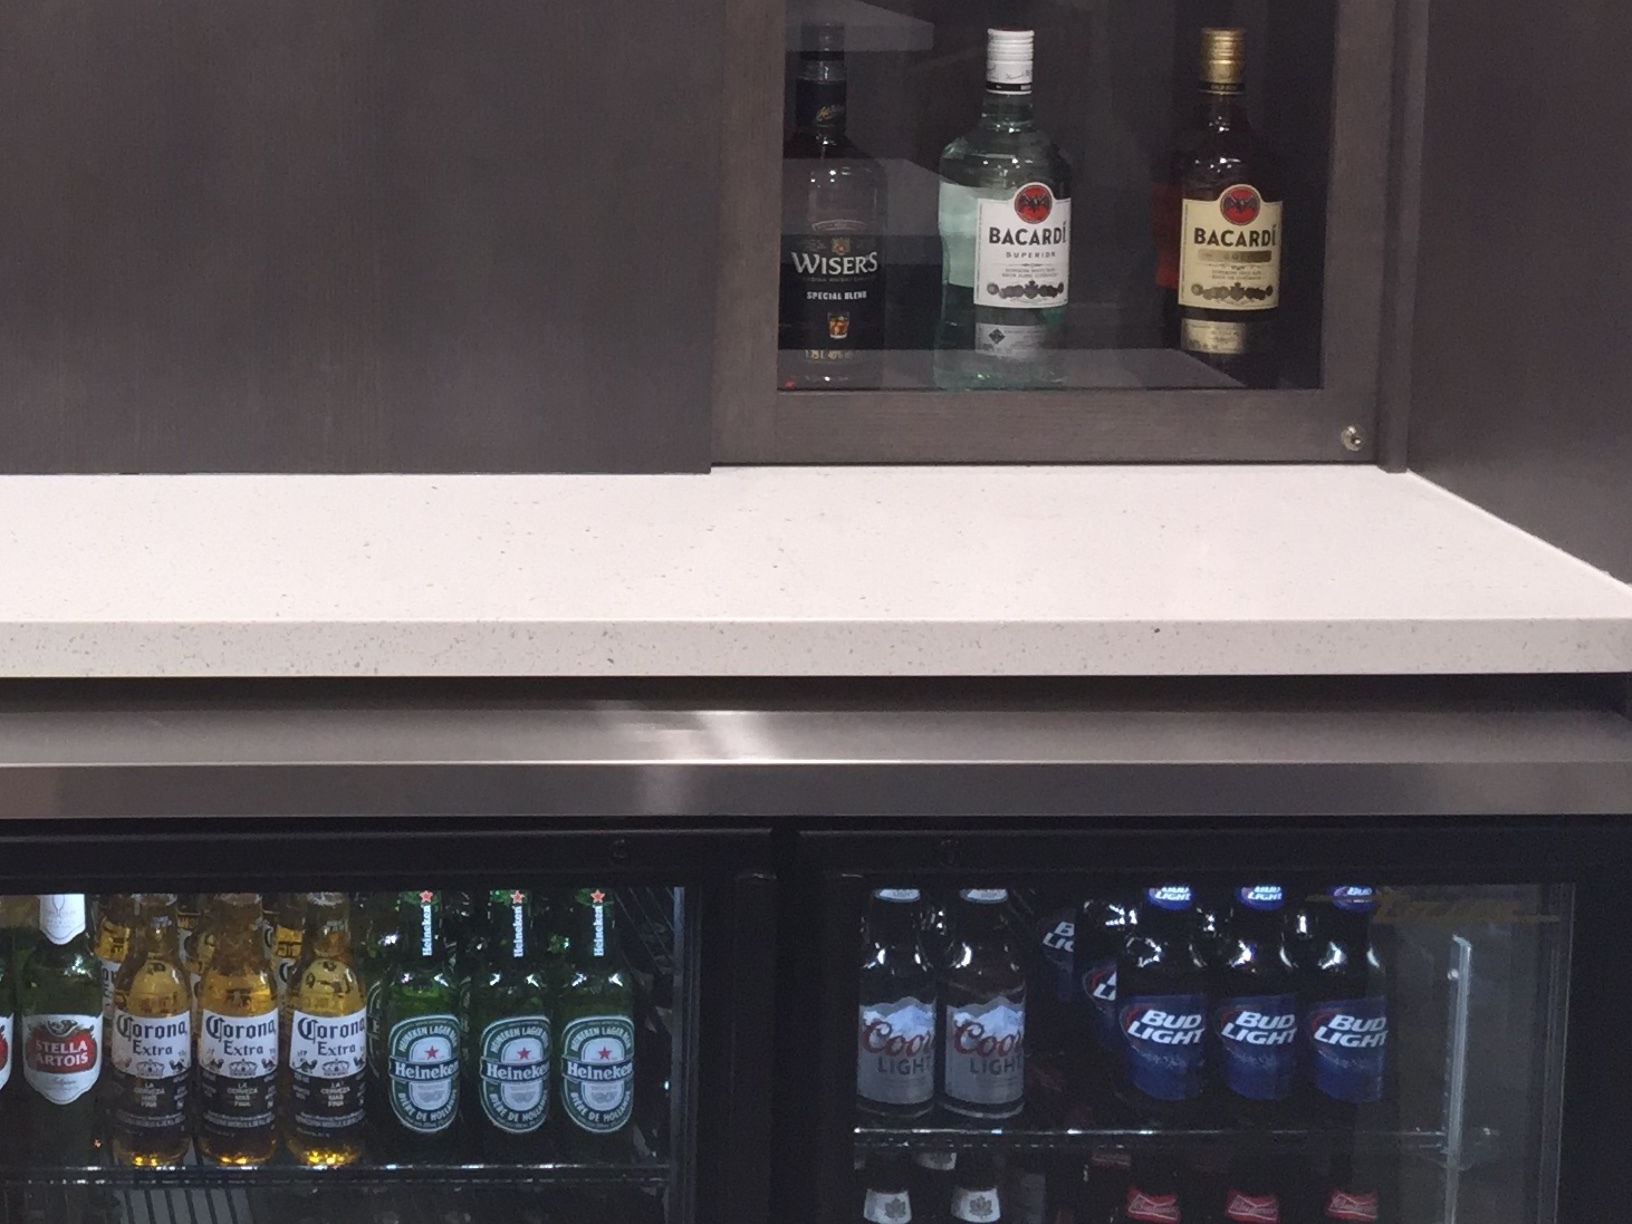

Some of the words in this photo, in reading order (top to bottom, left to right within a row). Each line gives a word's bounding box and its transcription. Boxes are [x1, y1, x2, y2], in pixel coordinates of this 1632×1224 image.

[988, 221, 1067, 247] BACARDÍ
[1194, 224, 1277, 248] BACARDÍ
[1005, 251, 1057, 259] SUPERIOR
[806, 290, 842, 300] SPECIAL
[844, 290, 868, 300] BLEND
[421, 903, 432, 956] Heineken
[512, 904, 524, 957] Heineken
[592, 903, 605, 956] Heineken
[118, 1014, 187, 1042] Corona
[205, 1014, 276, 1043] Corona
[297, 1016, 366, 1044] Corona
[1140, 1009, 1202, 1029] BUD
[1235, 1010, 1295, 1029] BUD
[1328, 1014, 1386, 1032] BUD
[1127, 1020, 1205, 1045] LIGHT
[1221, 1022, 1297, 1045] LIGHT
[1314, 1026, 1388, 1048] LIGHT
[35, 1040, 88, 1054] STELLA
[132, 1039, 173, 1056] Extra
[223, 1040, 264, 1056] Extra
[317, 1041, 356, 1056] Extra
[37, 1052, 88, 1068] ARTOIS
